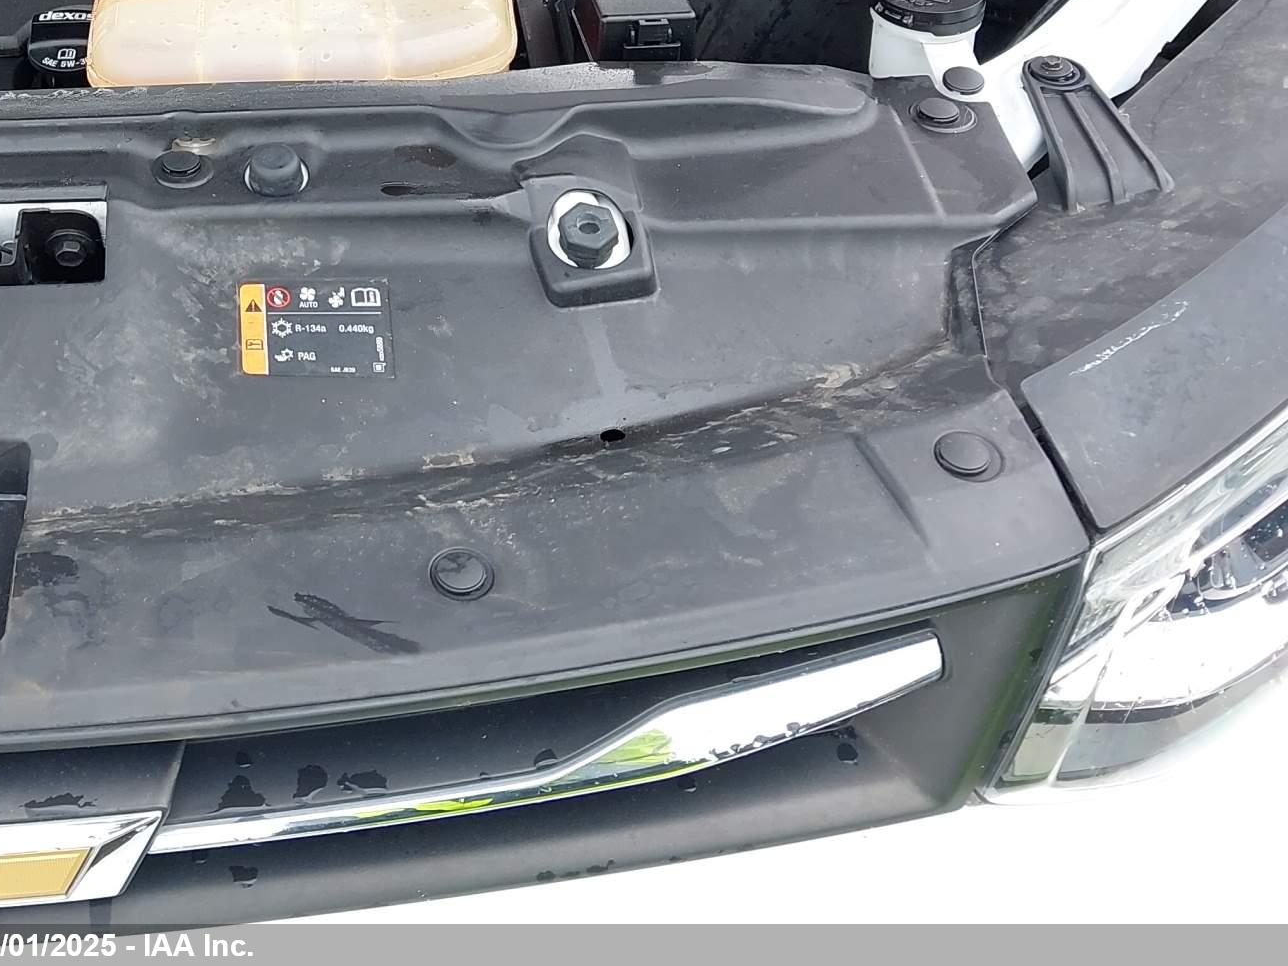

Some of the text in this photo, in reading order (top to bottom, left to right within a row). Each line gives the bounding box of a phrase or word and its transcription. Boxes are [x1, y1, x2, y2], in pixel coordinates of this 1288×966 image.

[41, 56, 87, 68] SAE 5W-3
[295, 324, 375, 334] R-134a 0.440kg
[298, 351, 317, 361] PAG
